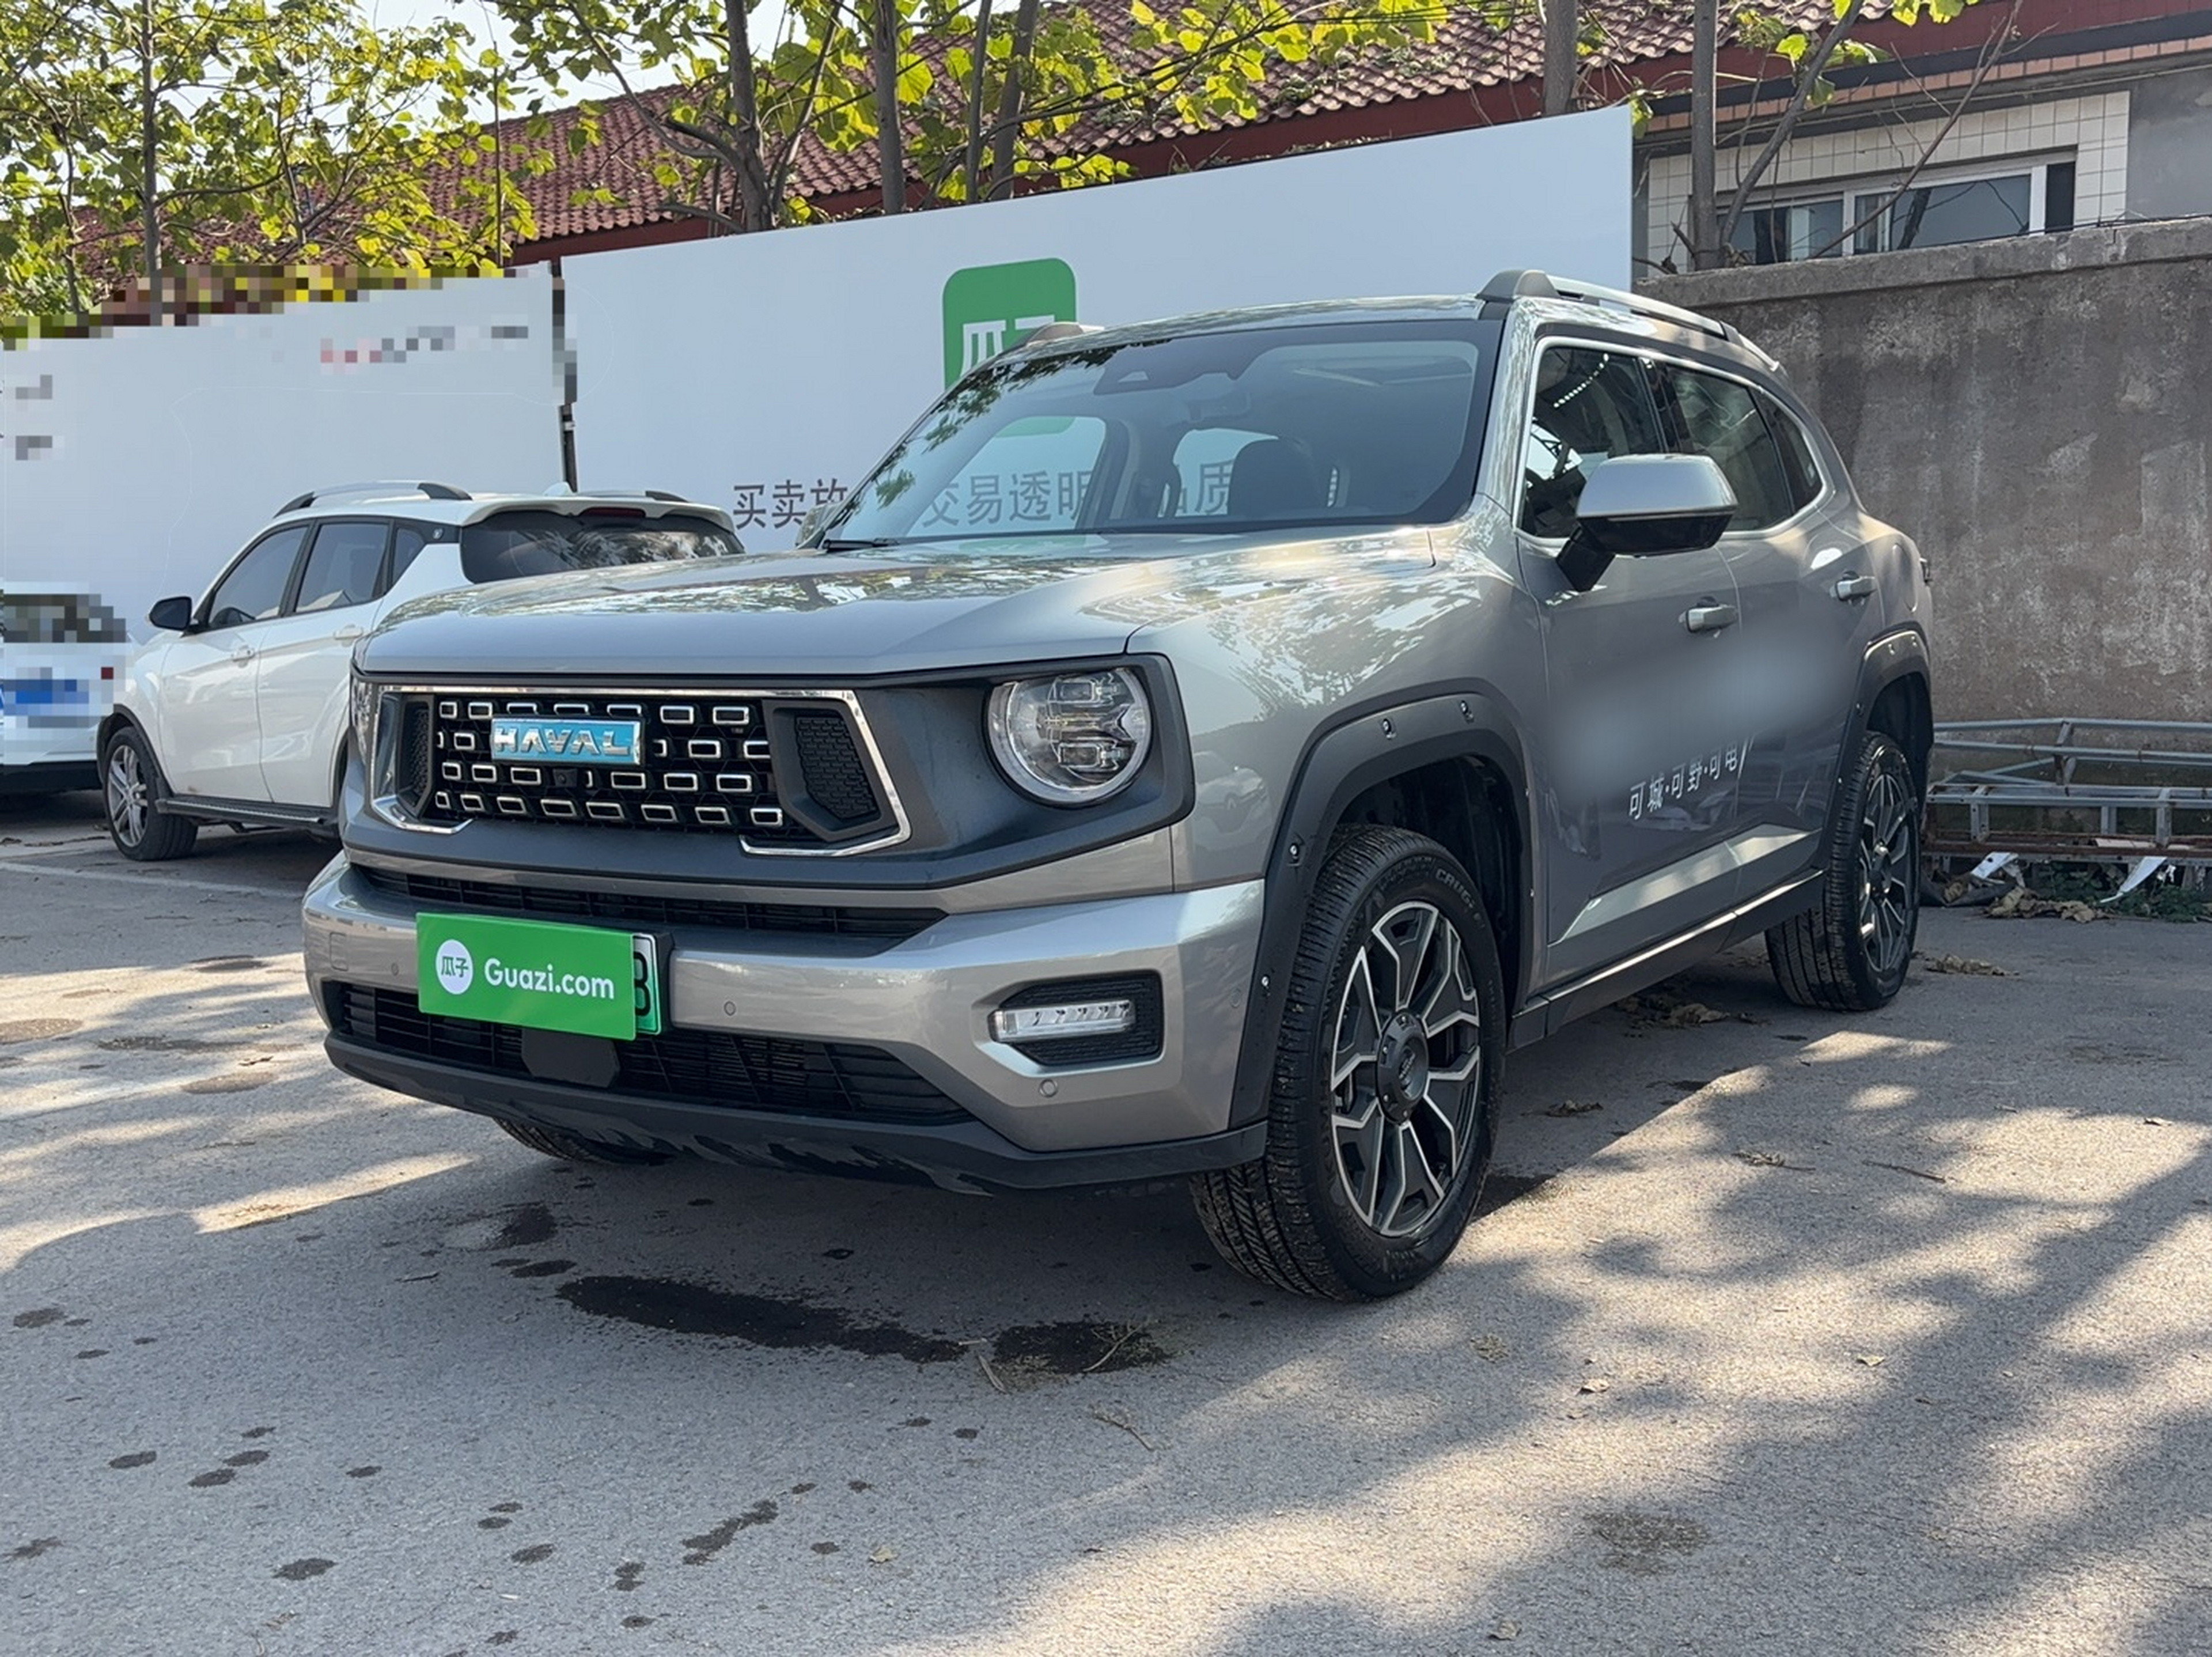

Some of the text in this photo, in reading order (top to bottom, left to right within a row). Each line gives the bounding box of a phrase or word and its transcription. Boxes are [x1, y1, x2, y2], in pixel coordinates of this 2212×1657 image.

[494, 728, 631, 756] HAVAL
[441, 955, 615, 1000] 瓜子 Guazi.com
